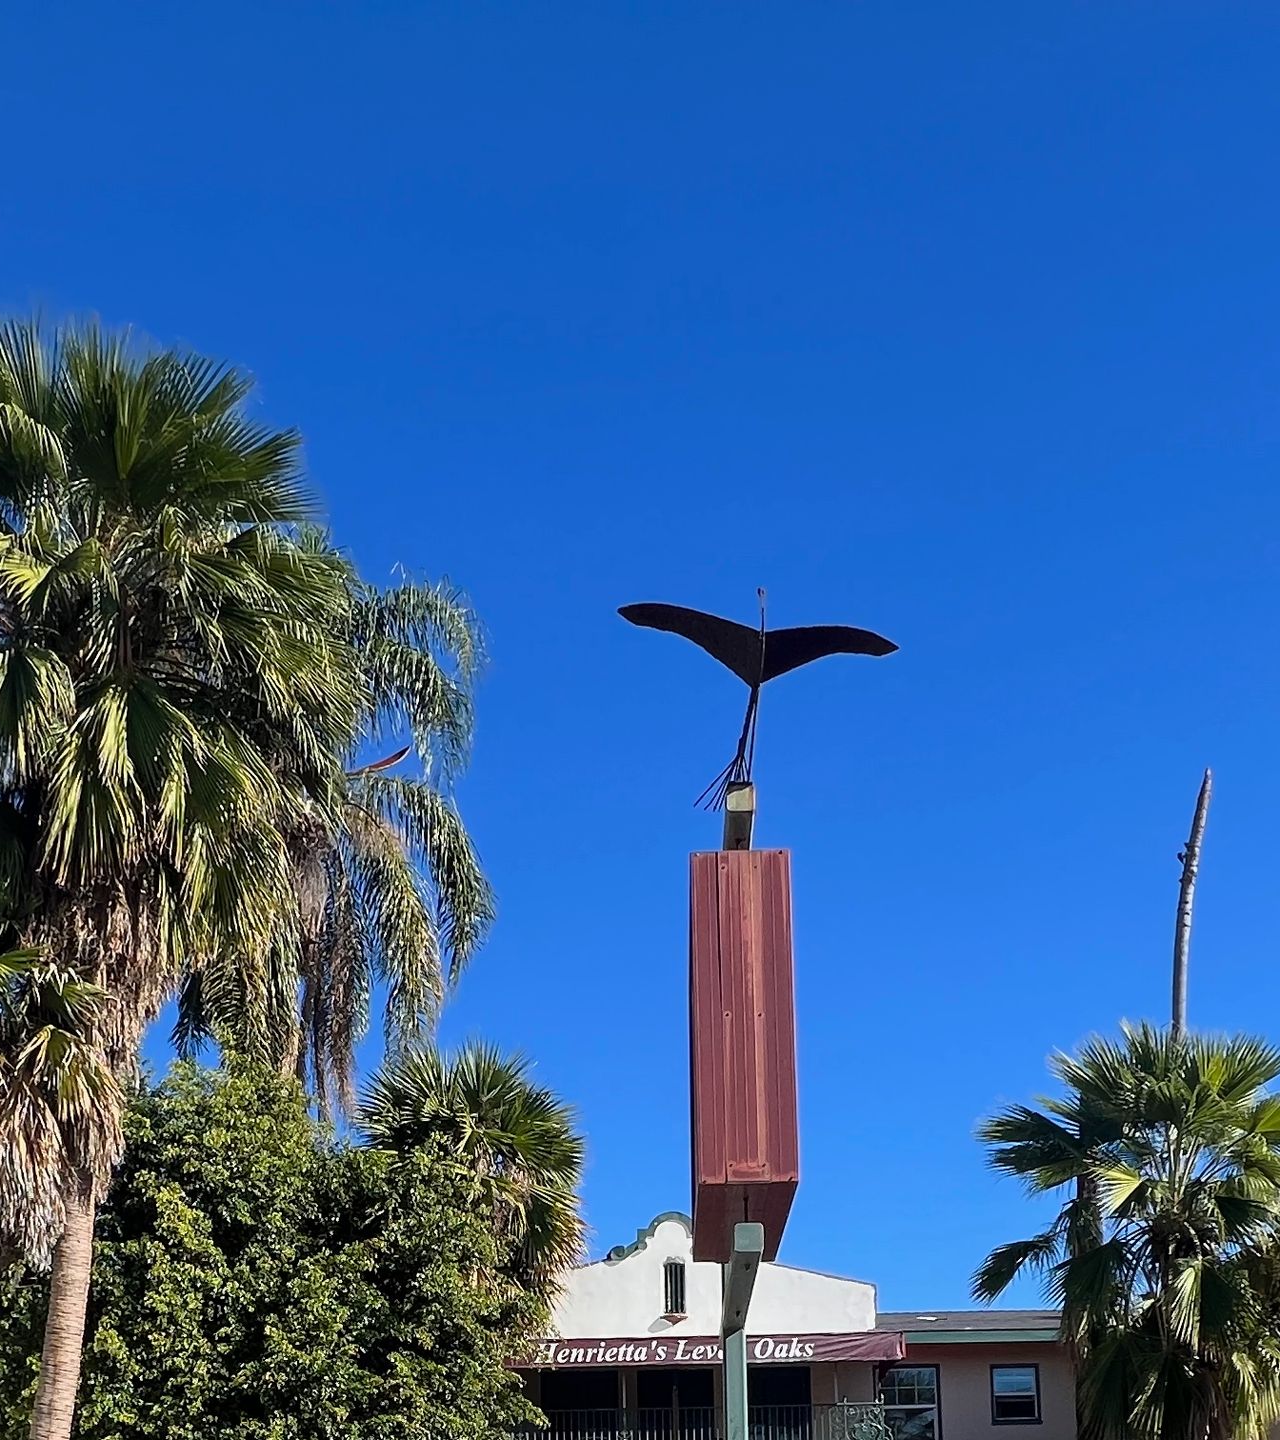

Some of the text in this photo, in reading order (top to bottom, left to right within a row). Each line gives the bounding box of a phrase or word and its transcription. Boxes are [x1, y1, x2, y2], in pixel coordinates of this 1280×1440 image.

[534, 1337, 815, 1364] Henrietta's Lev Oaks
